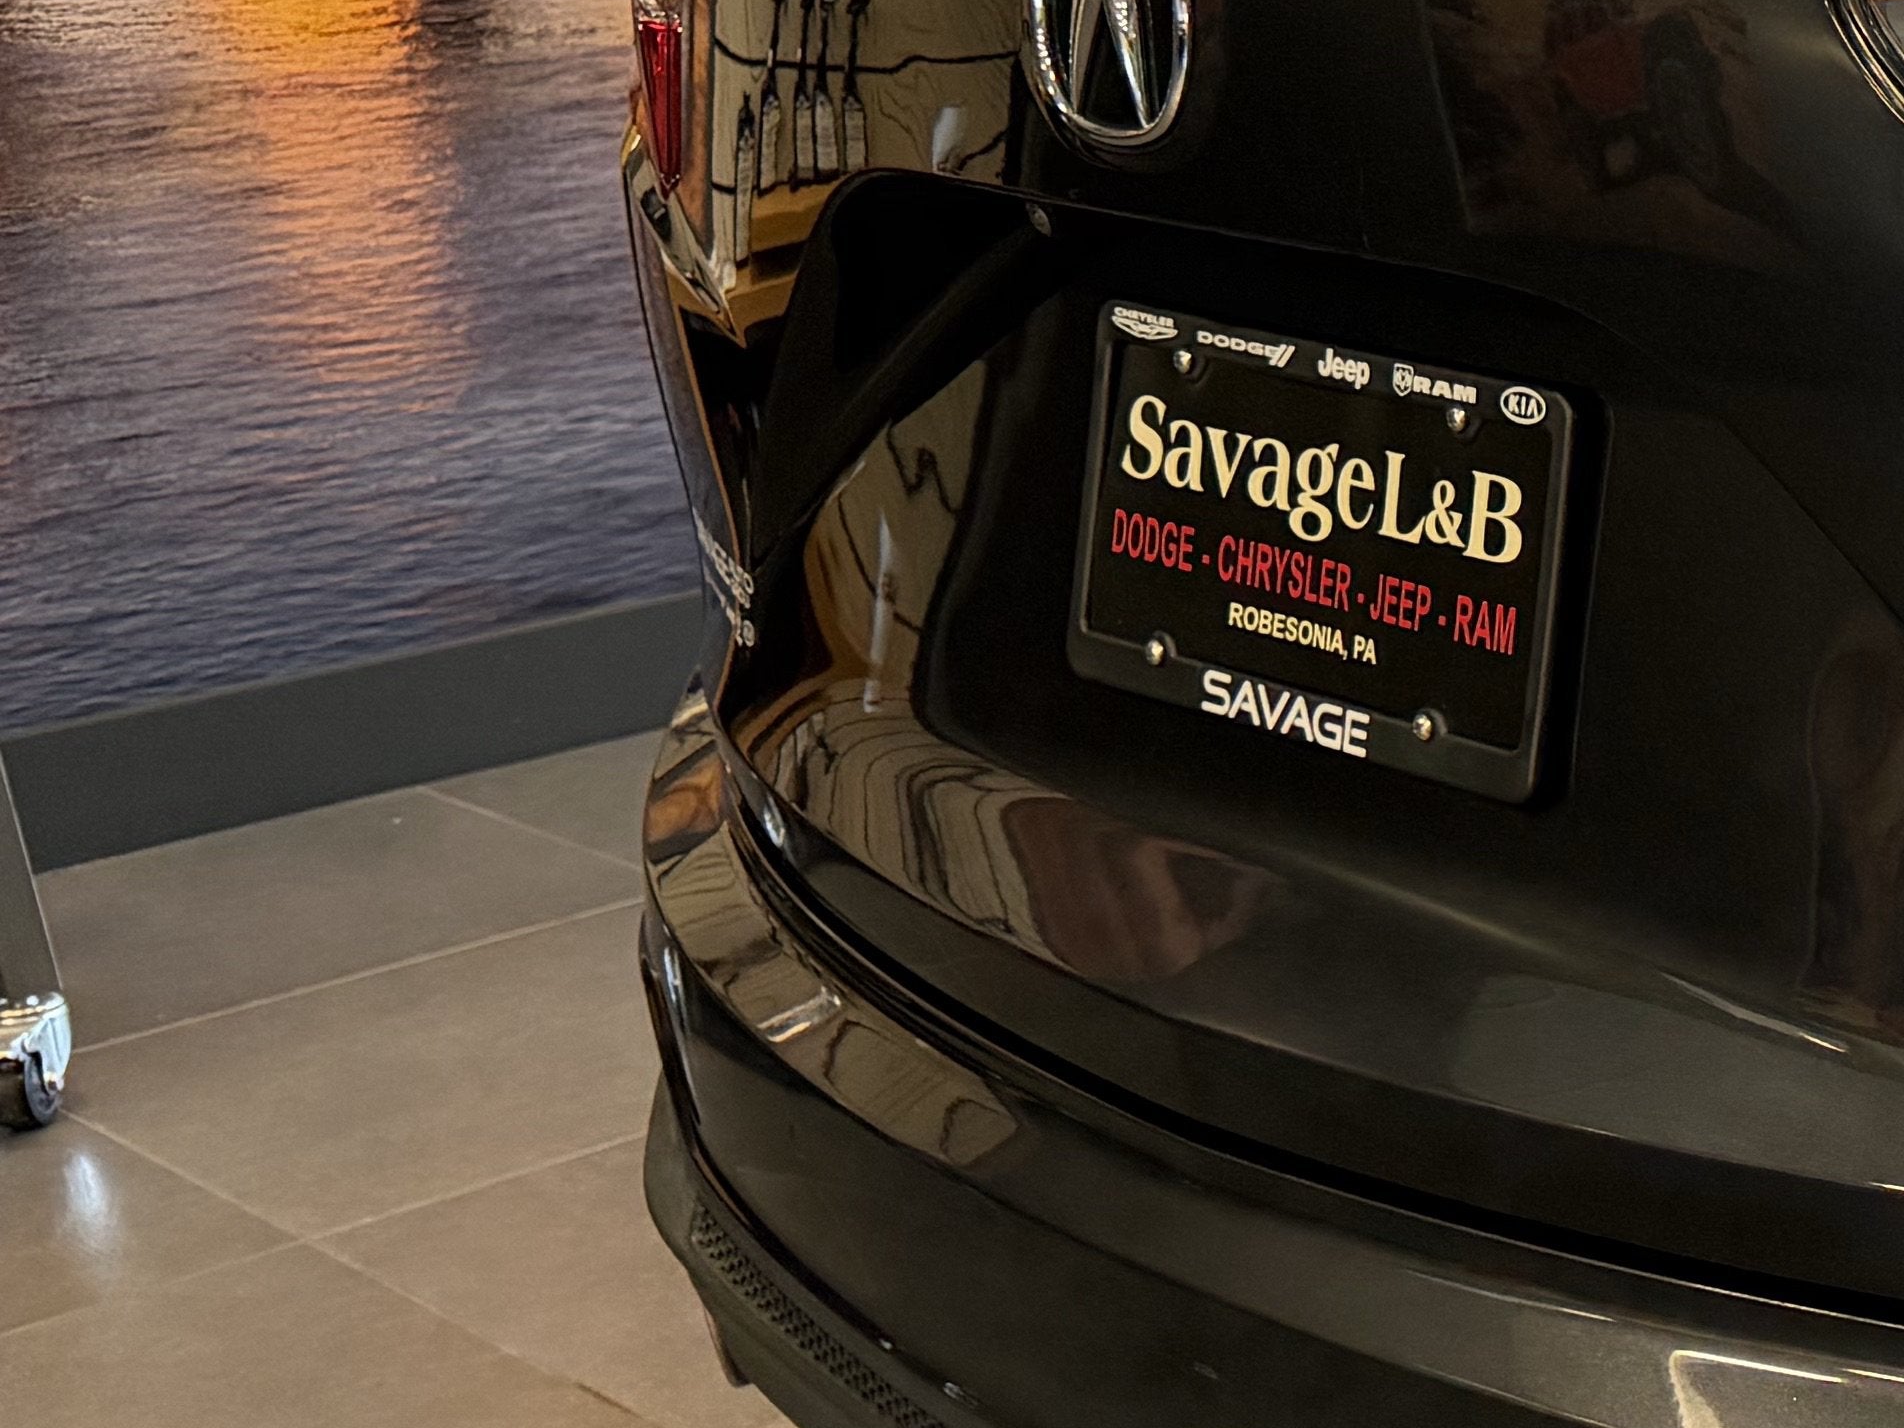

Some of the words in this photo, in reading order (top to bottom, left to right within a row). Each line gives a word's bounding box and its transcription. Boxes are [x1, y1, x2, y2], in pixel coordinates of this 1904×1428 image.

[1196, 330, 1281, 360] DODGE
[1317, 348, 1371, 389] Jeep
[1412, 375, 1477, 404] RAM
[1508, 393, 1539, 418] KIA
[1110, 508, 1196, 572] DODGE
[1217, 534, 1350, 612] CHRYSLER
[1369, 573, 1432, 632] JEEP
[1453, 594, 1517, 656] RAM
[1227, 601, 1348, 660] ROBESONIA,
[1352, 634, 1377, 665] PA
[1200, 669, 1371, 758] SAVAGE
